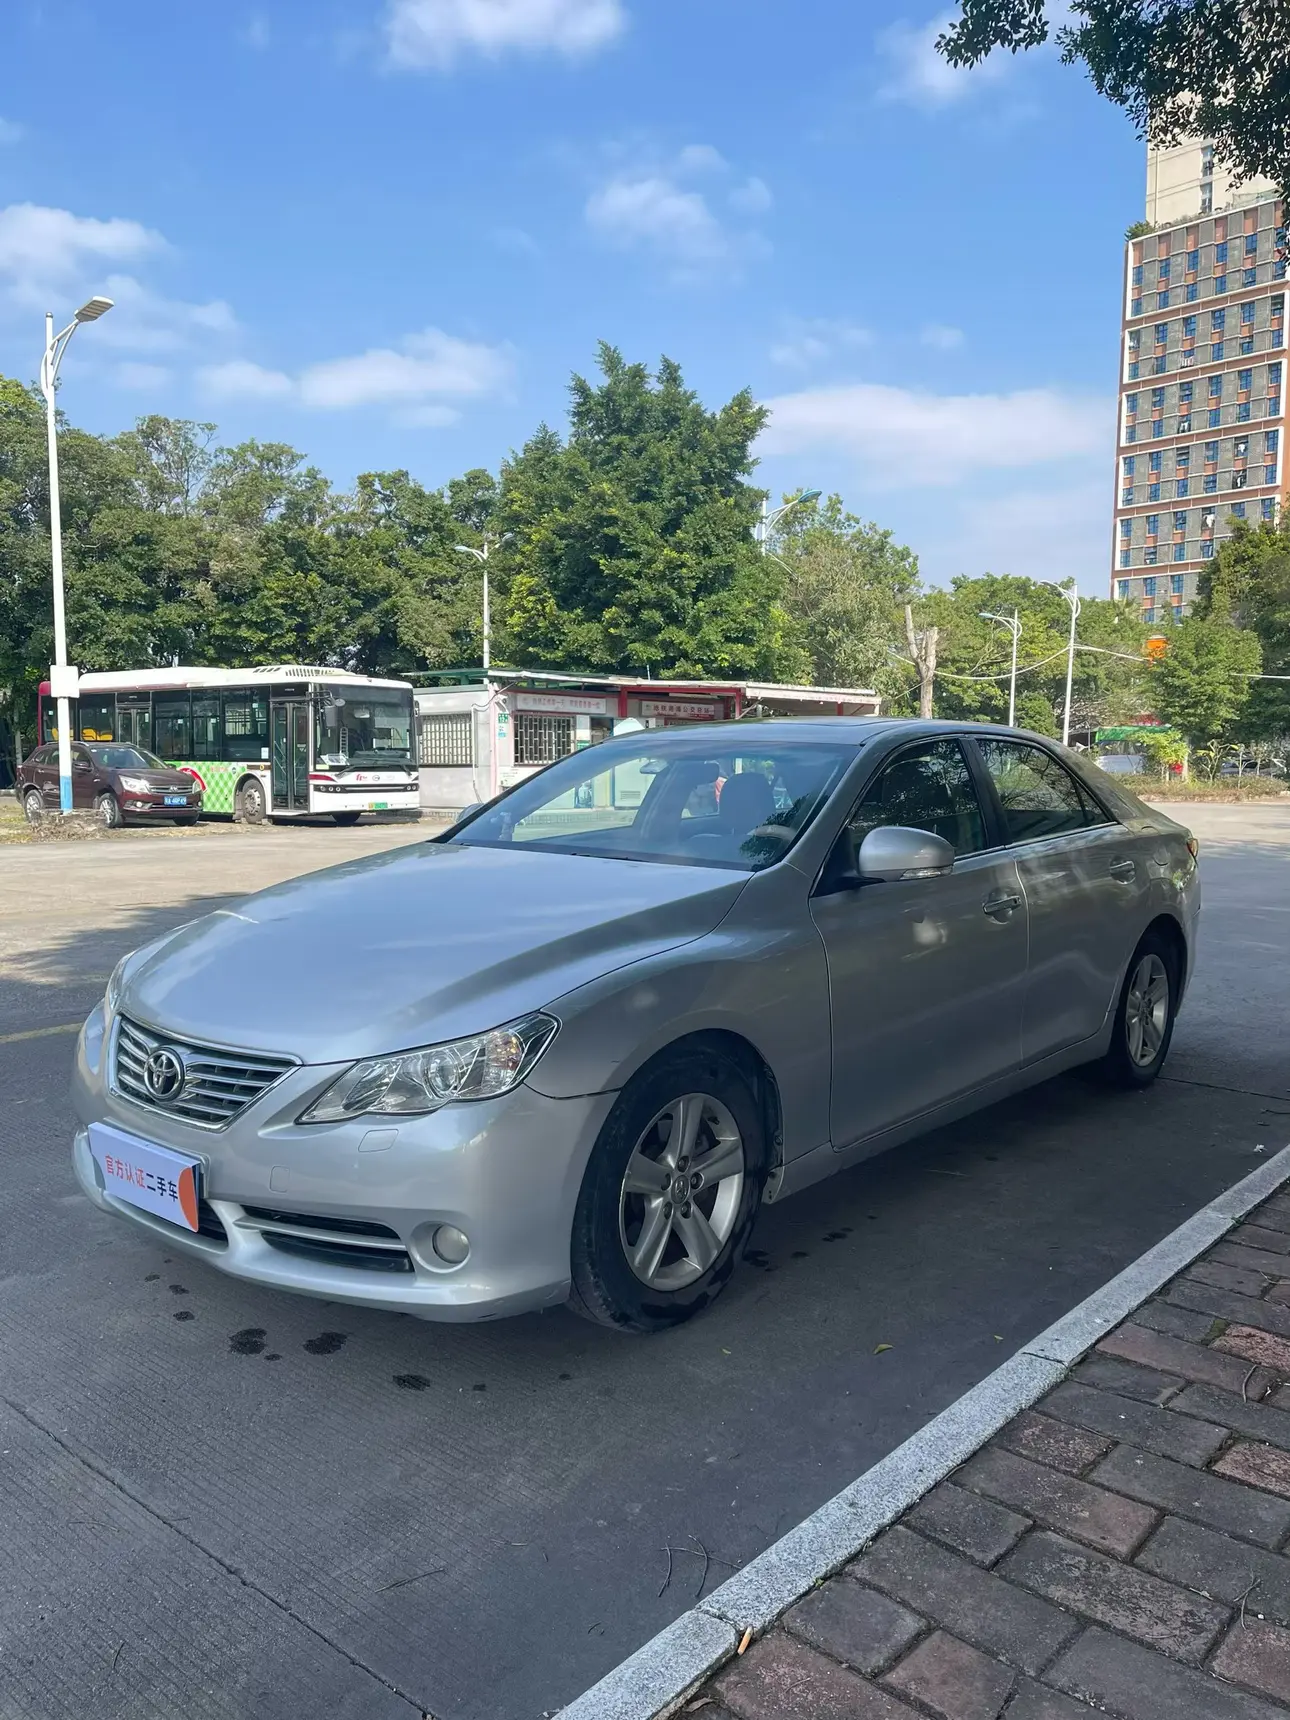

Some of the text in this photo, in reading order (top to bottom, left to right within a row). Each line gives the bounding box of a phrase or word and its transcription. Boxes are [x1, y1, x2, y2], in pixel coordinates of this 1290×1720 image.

[105, 1155, 179, 1202] 官方认证二手车
